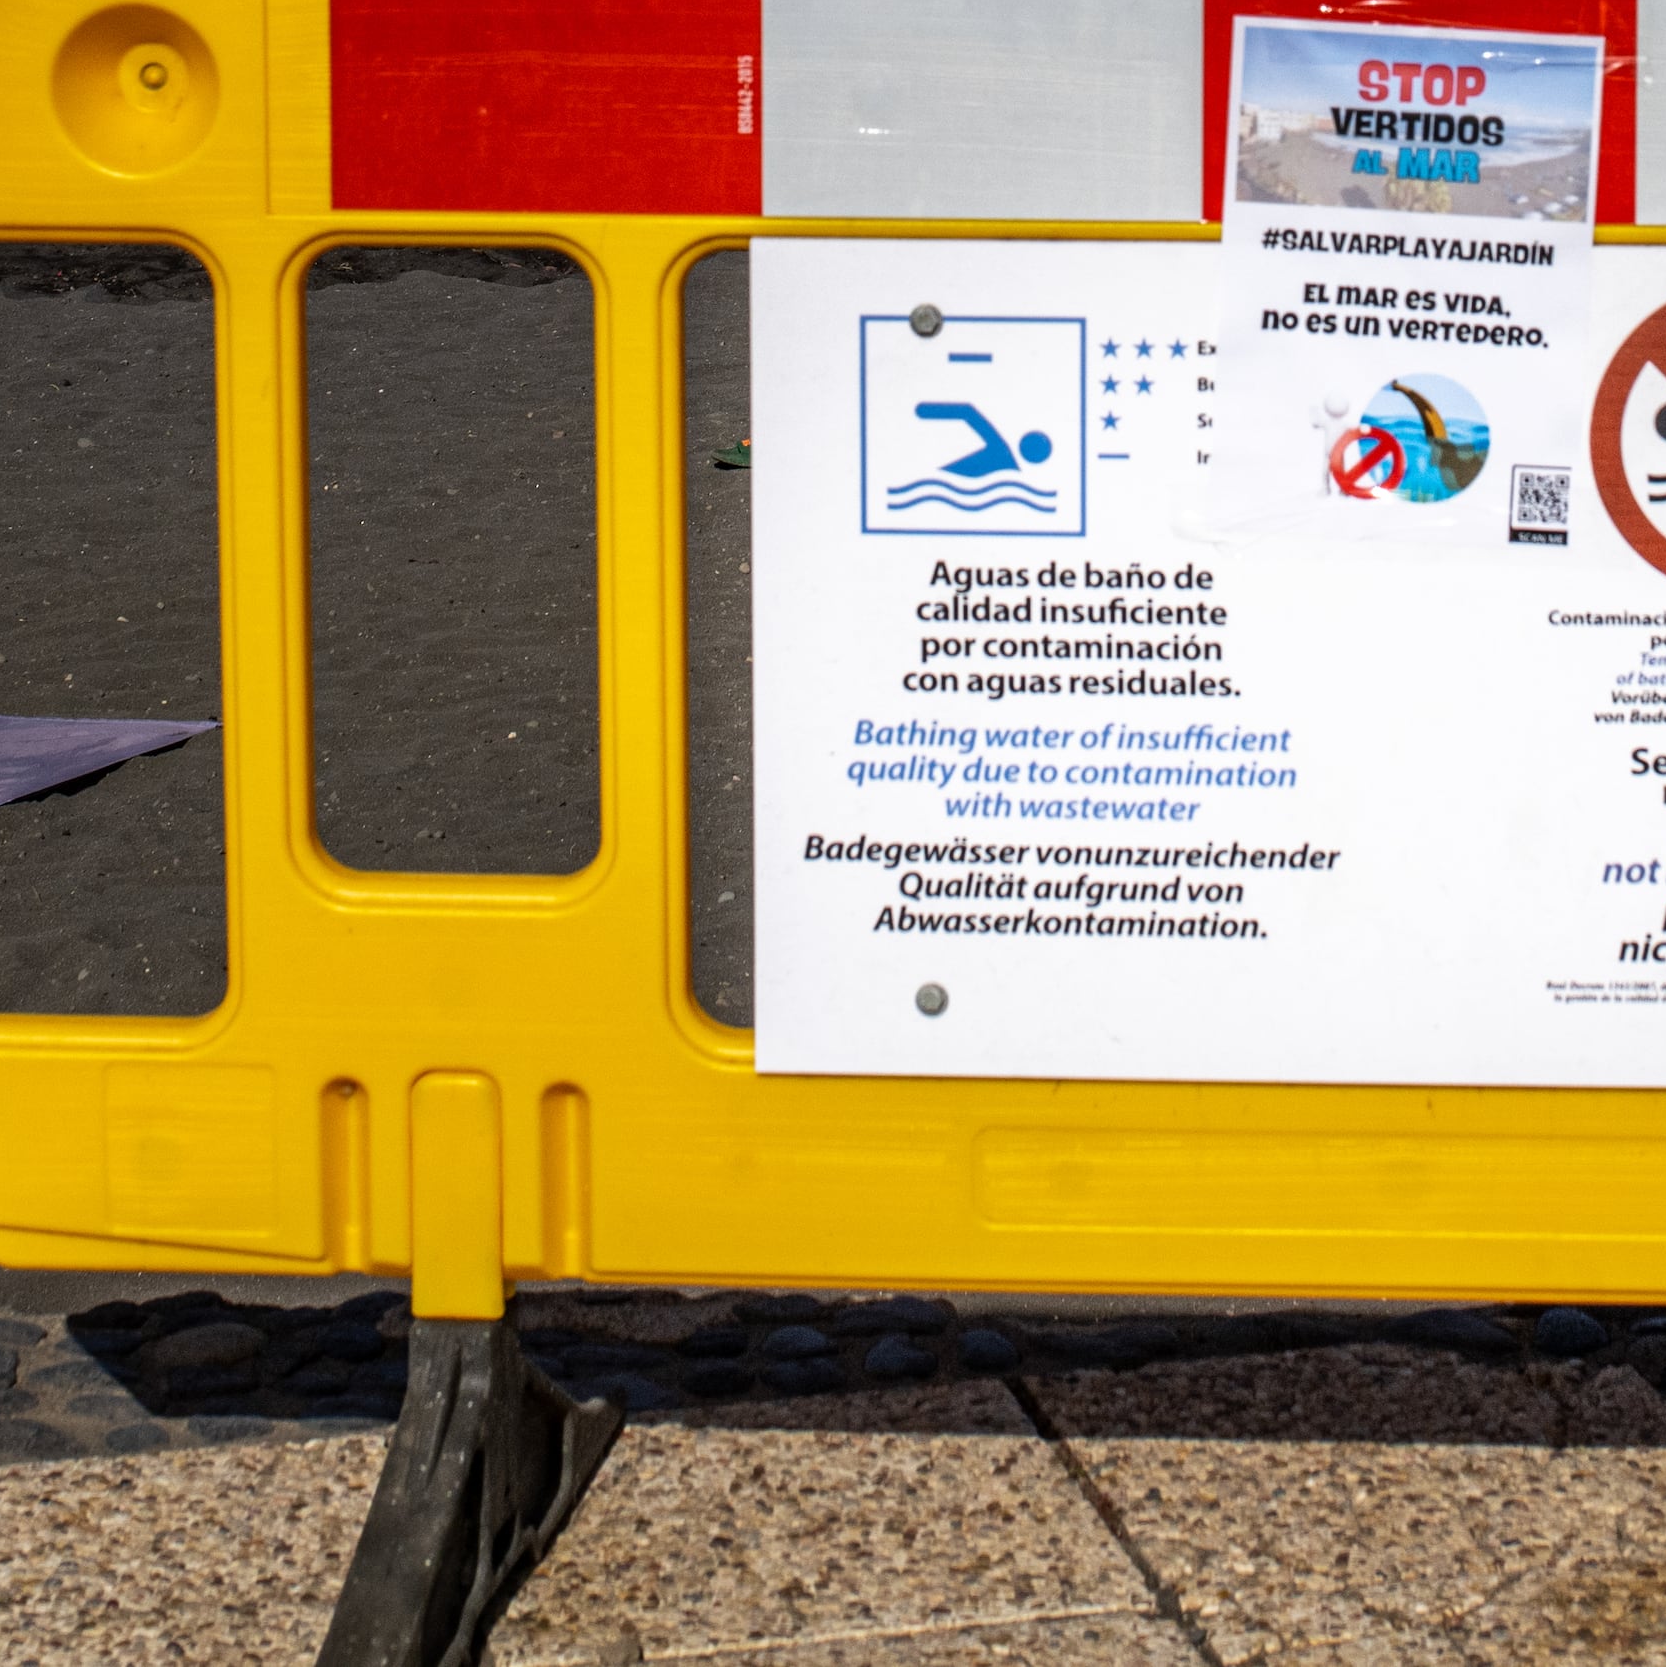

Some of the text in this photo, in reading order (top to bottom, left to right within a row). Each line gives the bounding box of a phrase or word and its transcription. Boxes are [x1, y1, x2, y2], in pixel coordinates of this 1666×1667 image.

[1358, 60, 1486, 106] STOP
[1331, 107, 1504, 147] VERTIDOS
[1352, 147, 1481, 184] AL MAR
[1261, 228, 1555, 266] #SALVARPLAYAJARDÍN
[930, 561, 1214, 594] Aguas de baño de
[916, 595, 1228, 626] calidad insuficiente
[921, 634, 1223, 663] por contaminación
[902, 669, 1242, 700] con aguas residuales.
[1616, 672, 1636, 687] of
[1594, 712, 1625, 724] von
[854, 720, 1291, 754] Bathing water of insufficient
[847, 756, 1297, 789] quality due to contamination
[945, 793, 1201, 821] with wastewater
[803, 835, 1342, 870] Badegewässer vonunzureichender
[1602, 859, 1660, 884] not
[899, 872, 1244, 908] Qualität aufgrund von
[873, 907, 1268, 940] Abwasserkontamination.
